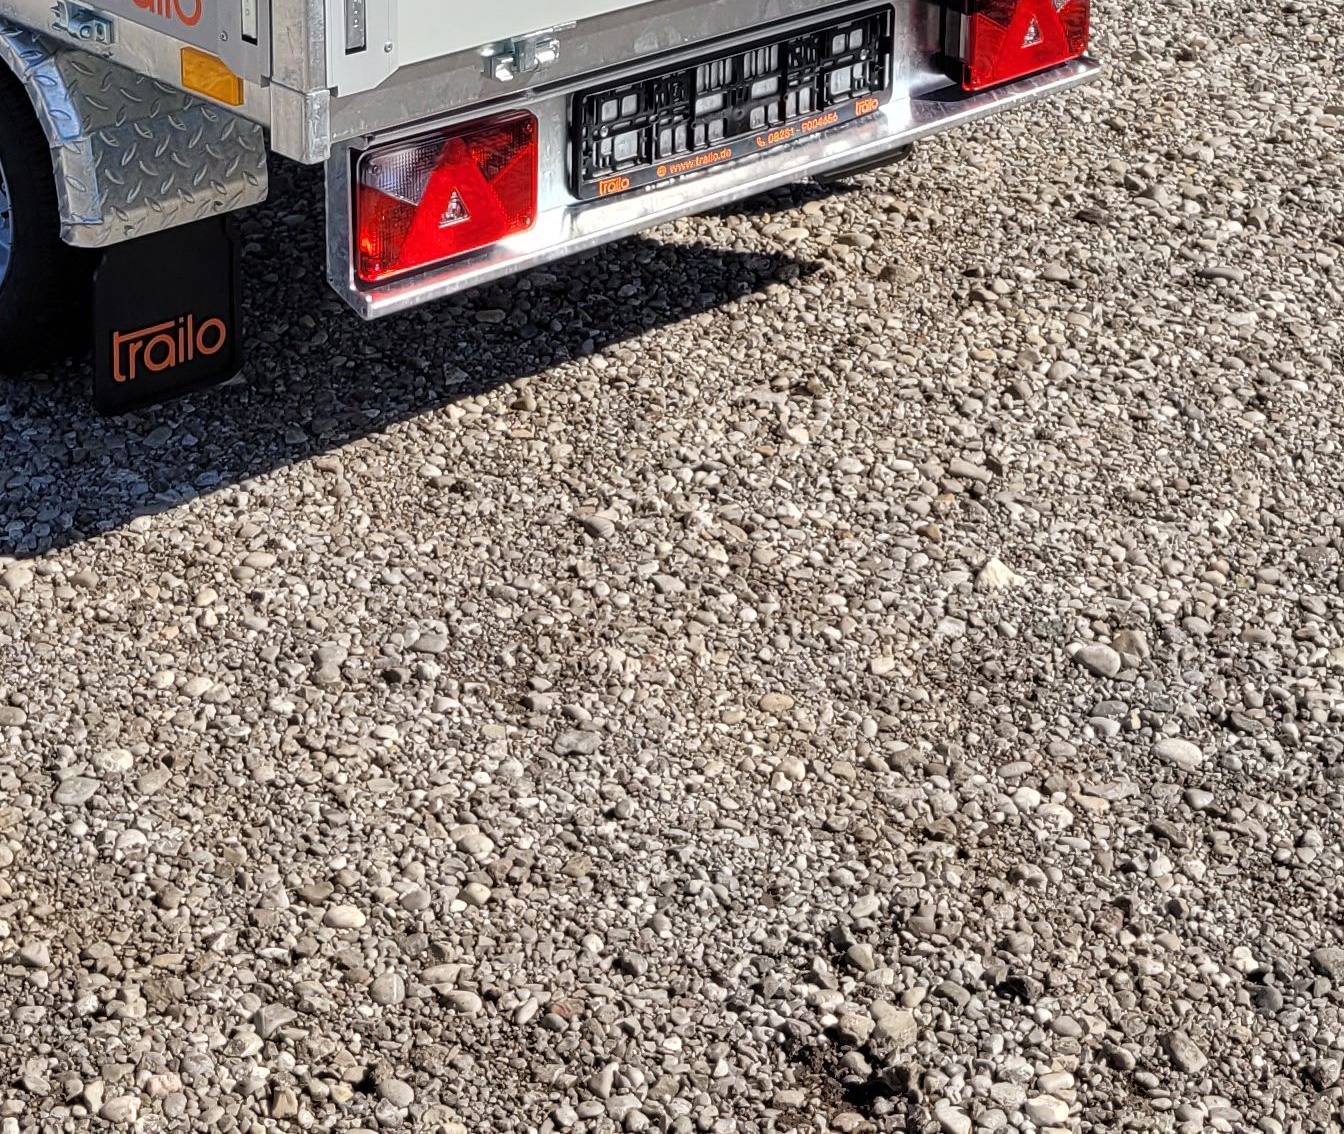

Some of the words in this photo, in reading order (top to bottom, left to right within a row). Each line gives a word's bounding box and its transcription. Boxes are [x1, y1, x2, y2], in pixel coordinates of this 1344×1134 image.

[598, 176, 631, 197] trailo
[855, 97, 880, 117] trailo
[112, 313, 227, 383] trailo
